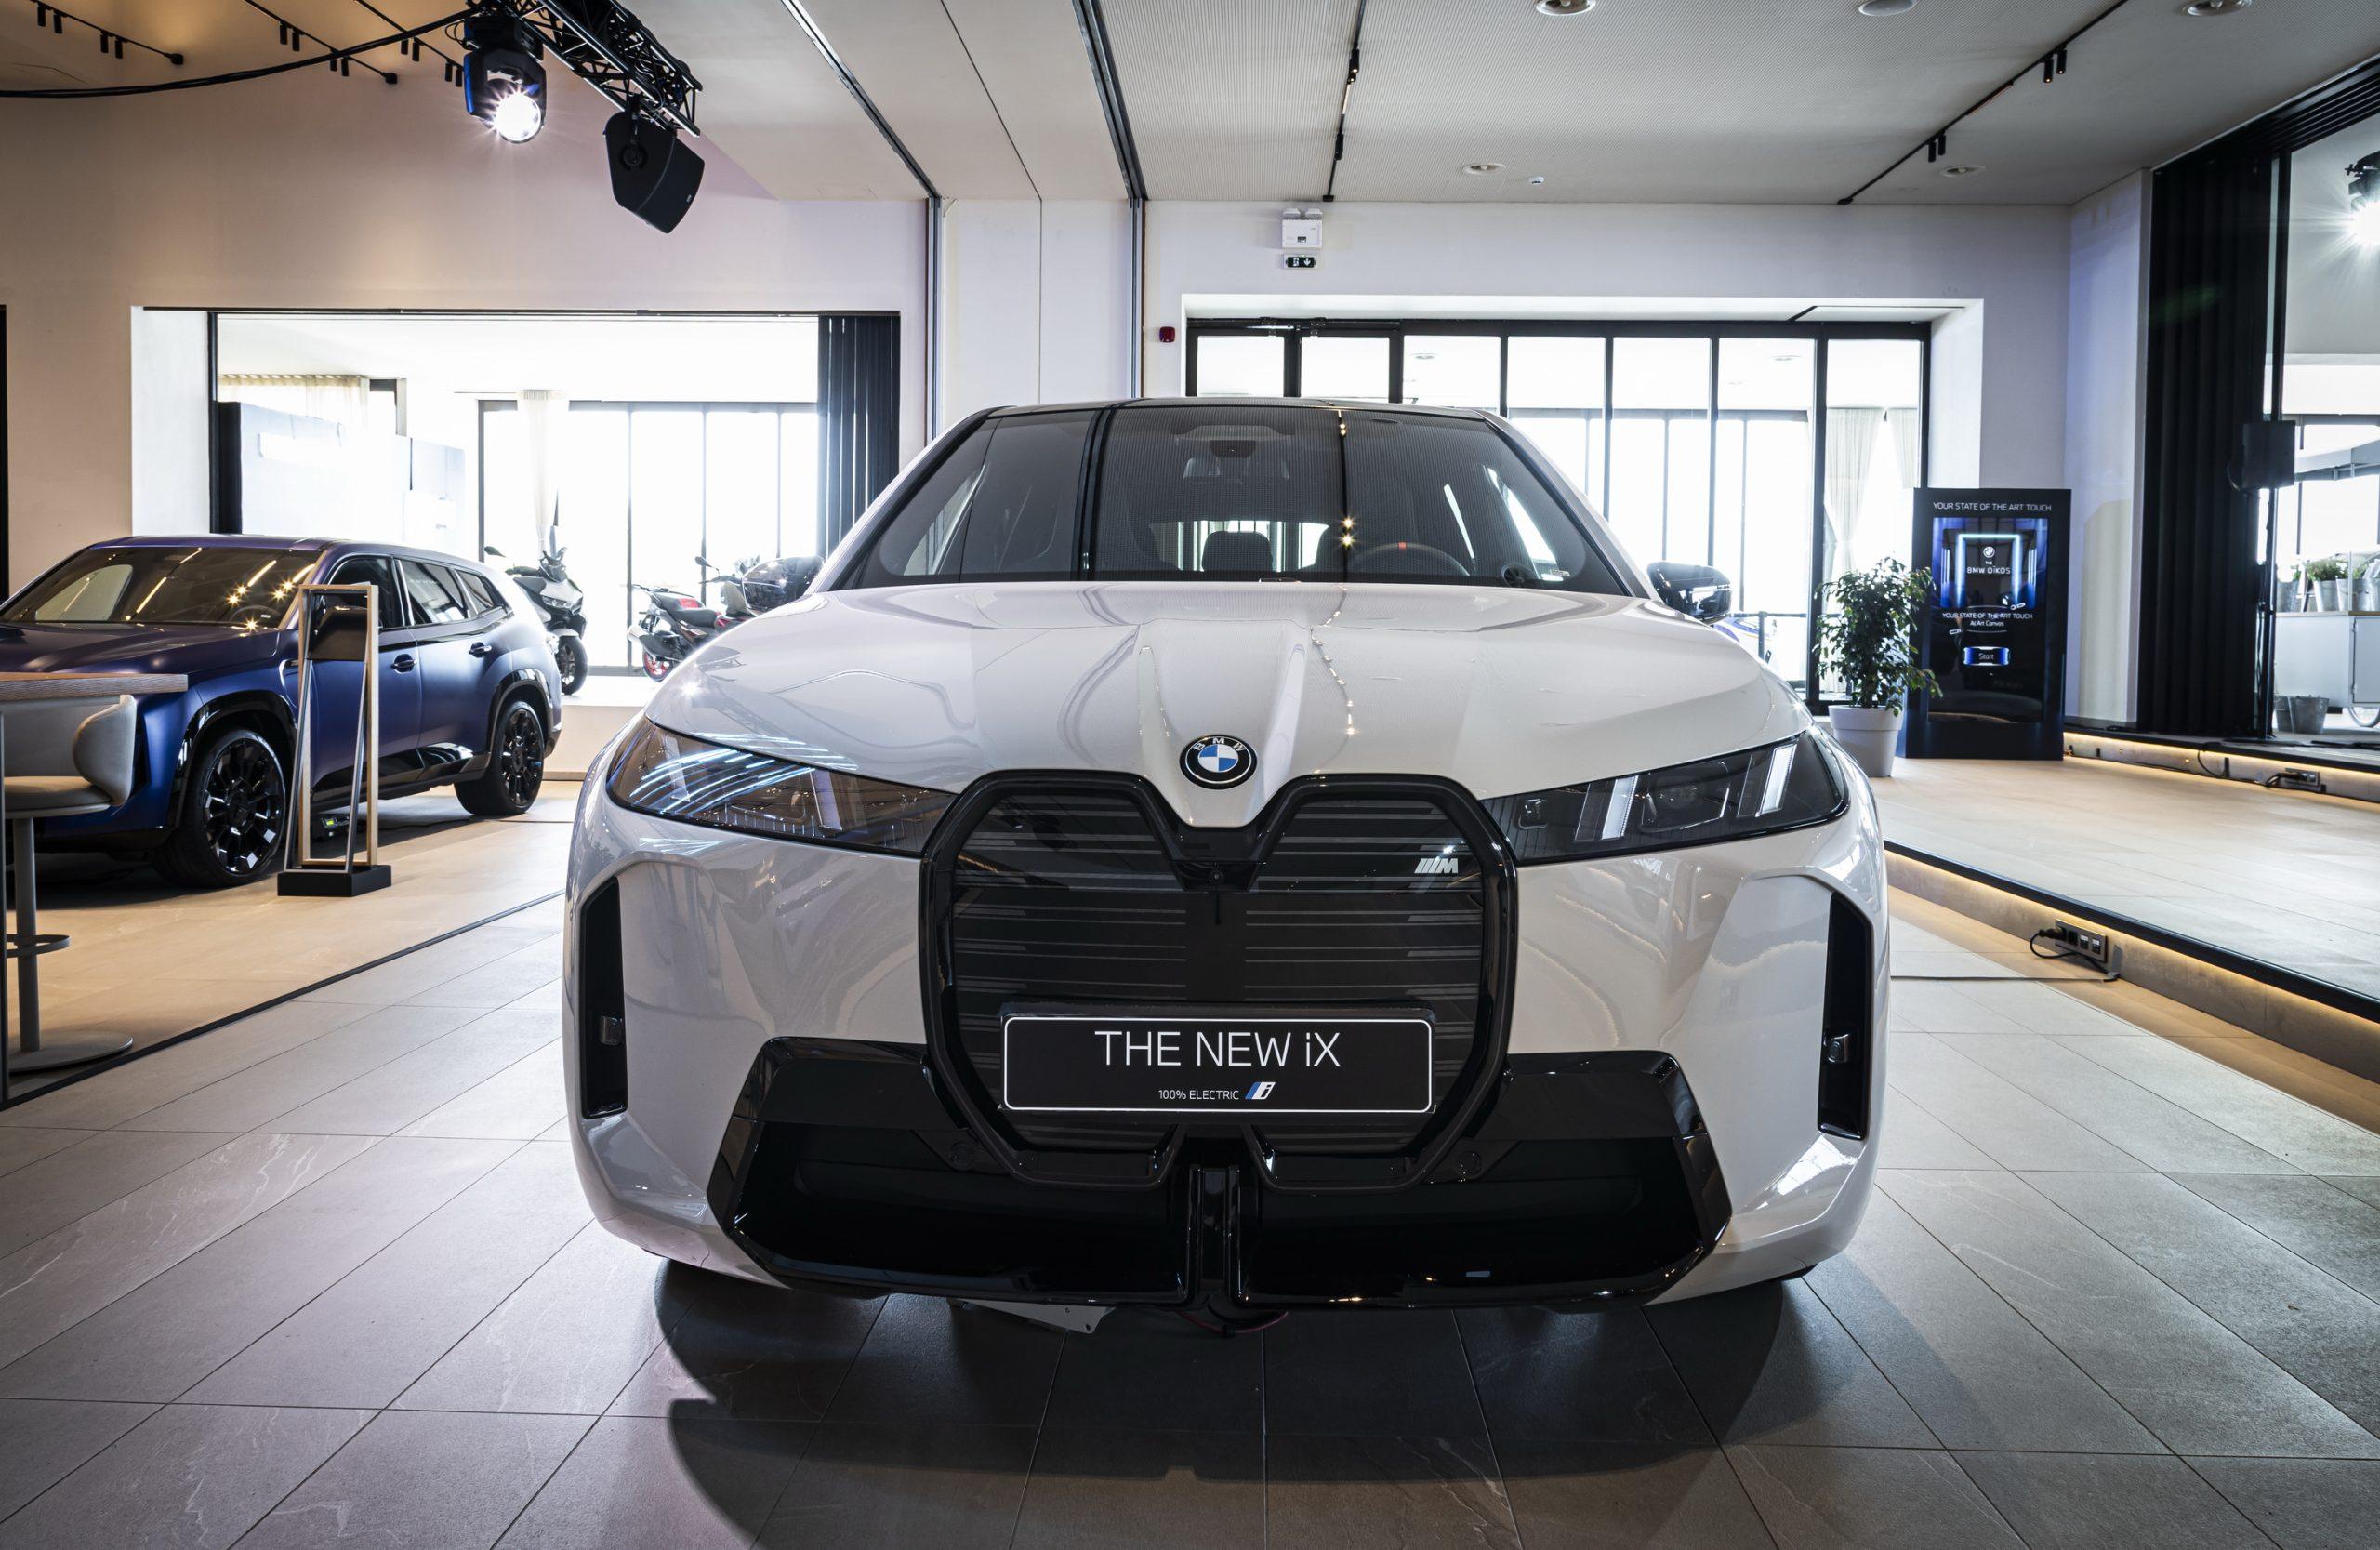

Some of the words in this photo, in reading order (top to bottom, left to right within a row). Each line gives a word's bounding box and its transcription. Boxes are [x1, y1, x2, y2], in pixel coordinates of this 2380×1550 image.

[1933, 501, 1954, 510] YOUR
[1955, 502, 1978, 510] STATE
[1979, 502, 1990, 510] OF
[1992, 503, 2007, 511] THE
[2008, 503, 2024, 511] ART
[2027, 503, 2052, 511] TOUCH
[1978, 652, 1994, 660] Start
[1192, 737, 1246, 751] BMW
[1094, 1029, 1182, 1066] THE
[1196, 1030, 1291, 1067] NEW
[1305, 1031, 1341, 1068] iX
[1158, 1089, 1187, 1100] 100%
[1189, 1090, 1239, 1101] ELECTRIC
